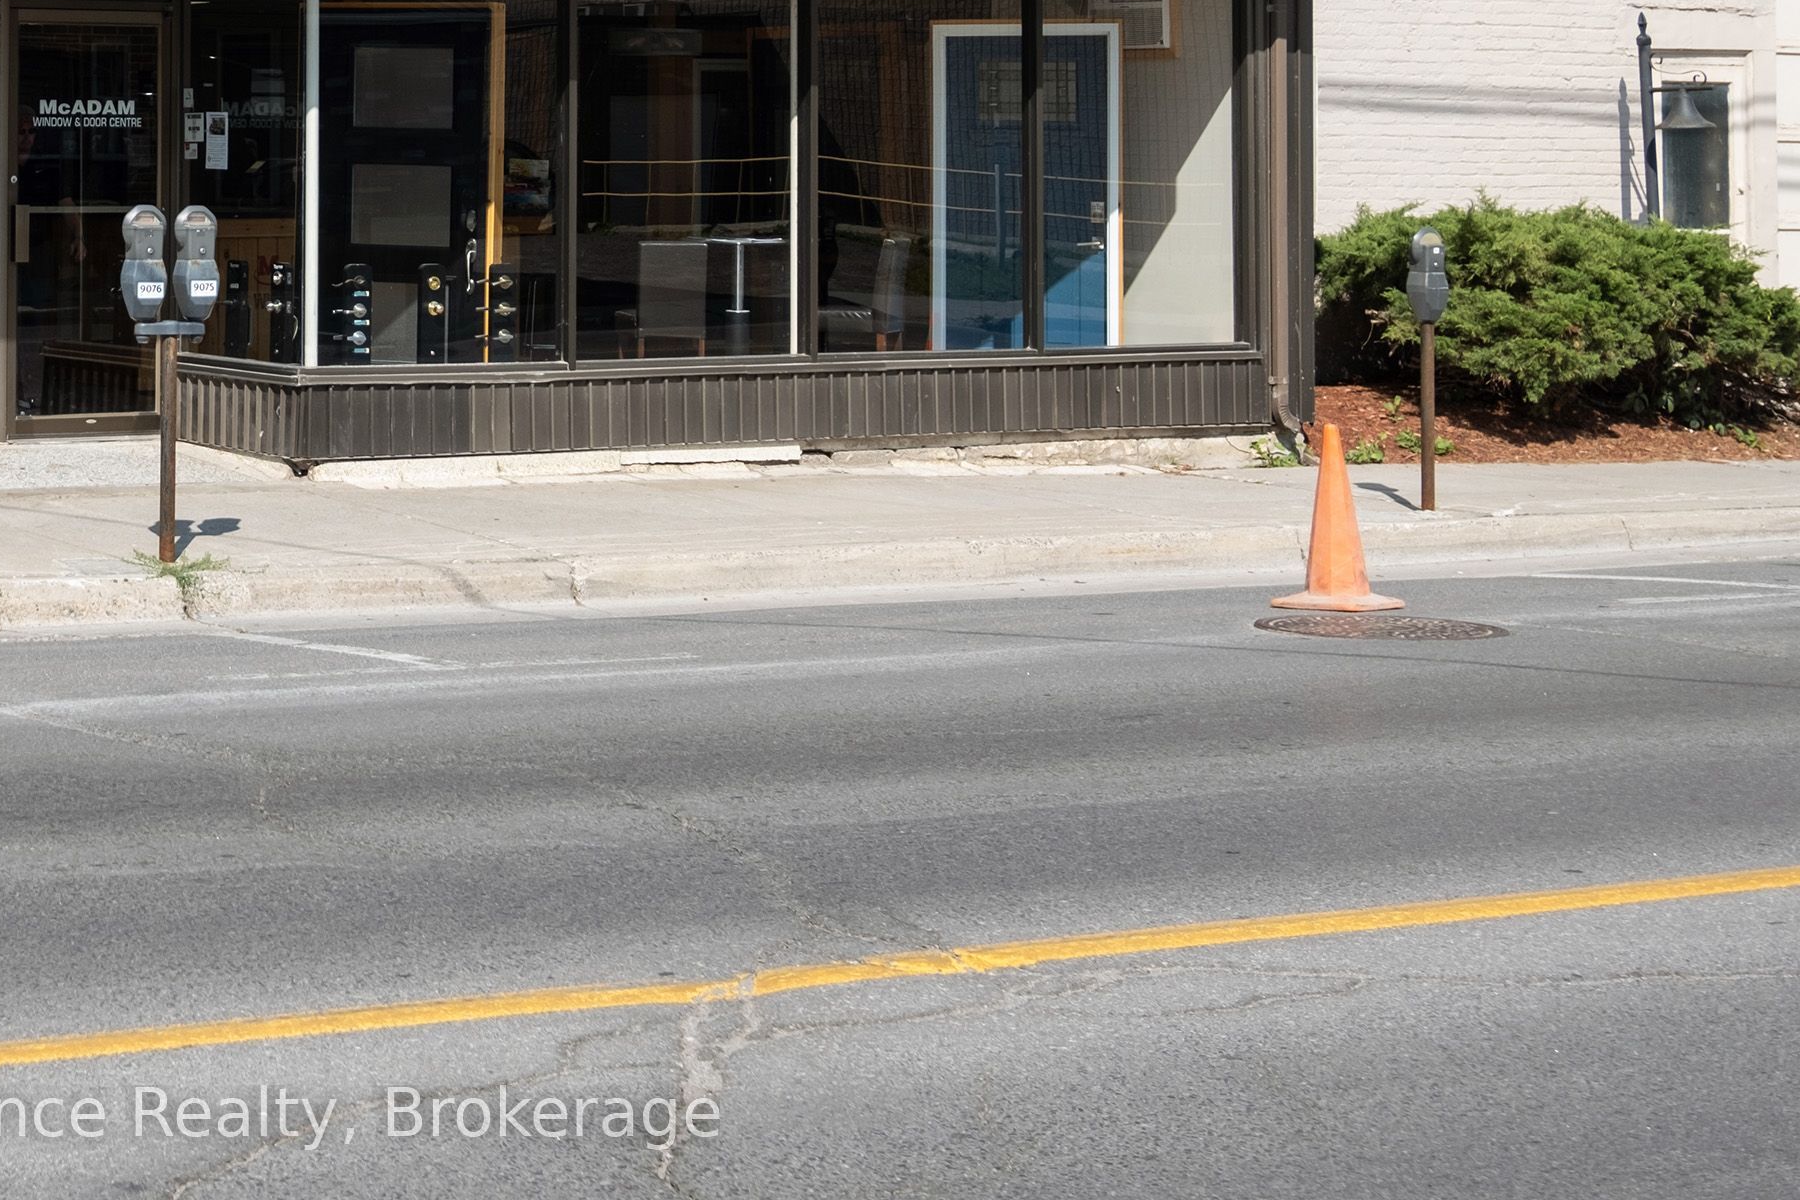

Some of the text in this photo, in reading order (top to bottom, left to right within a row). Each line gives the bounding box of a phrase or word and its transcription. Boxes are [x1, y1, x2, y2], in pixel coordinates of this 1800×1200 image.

[39, 99, 136, 115] McADAM
[32, 116, 142, 128] WINDOW & DOOR CENTRE
[140, 282, 215, 293] 9076 9075
